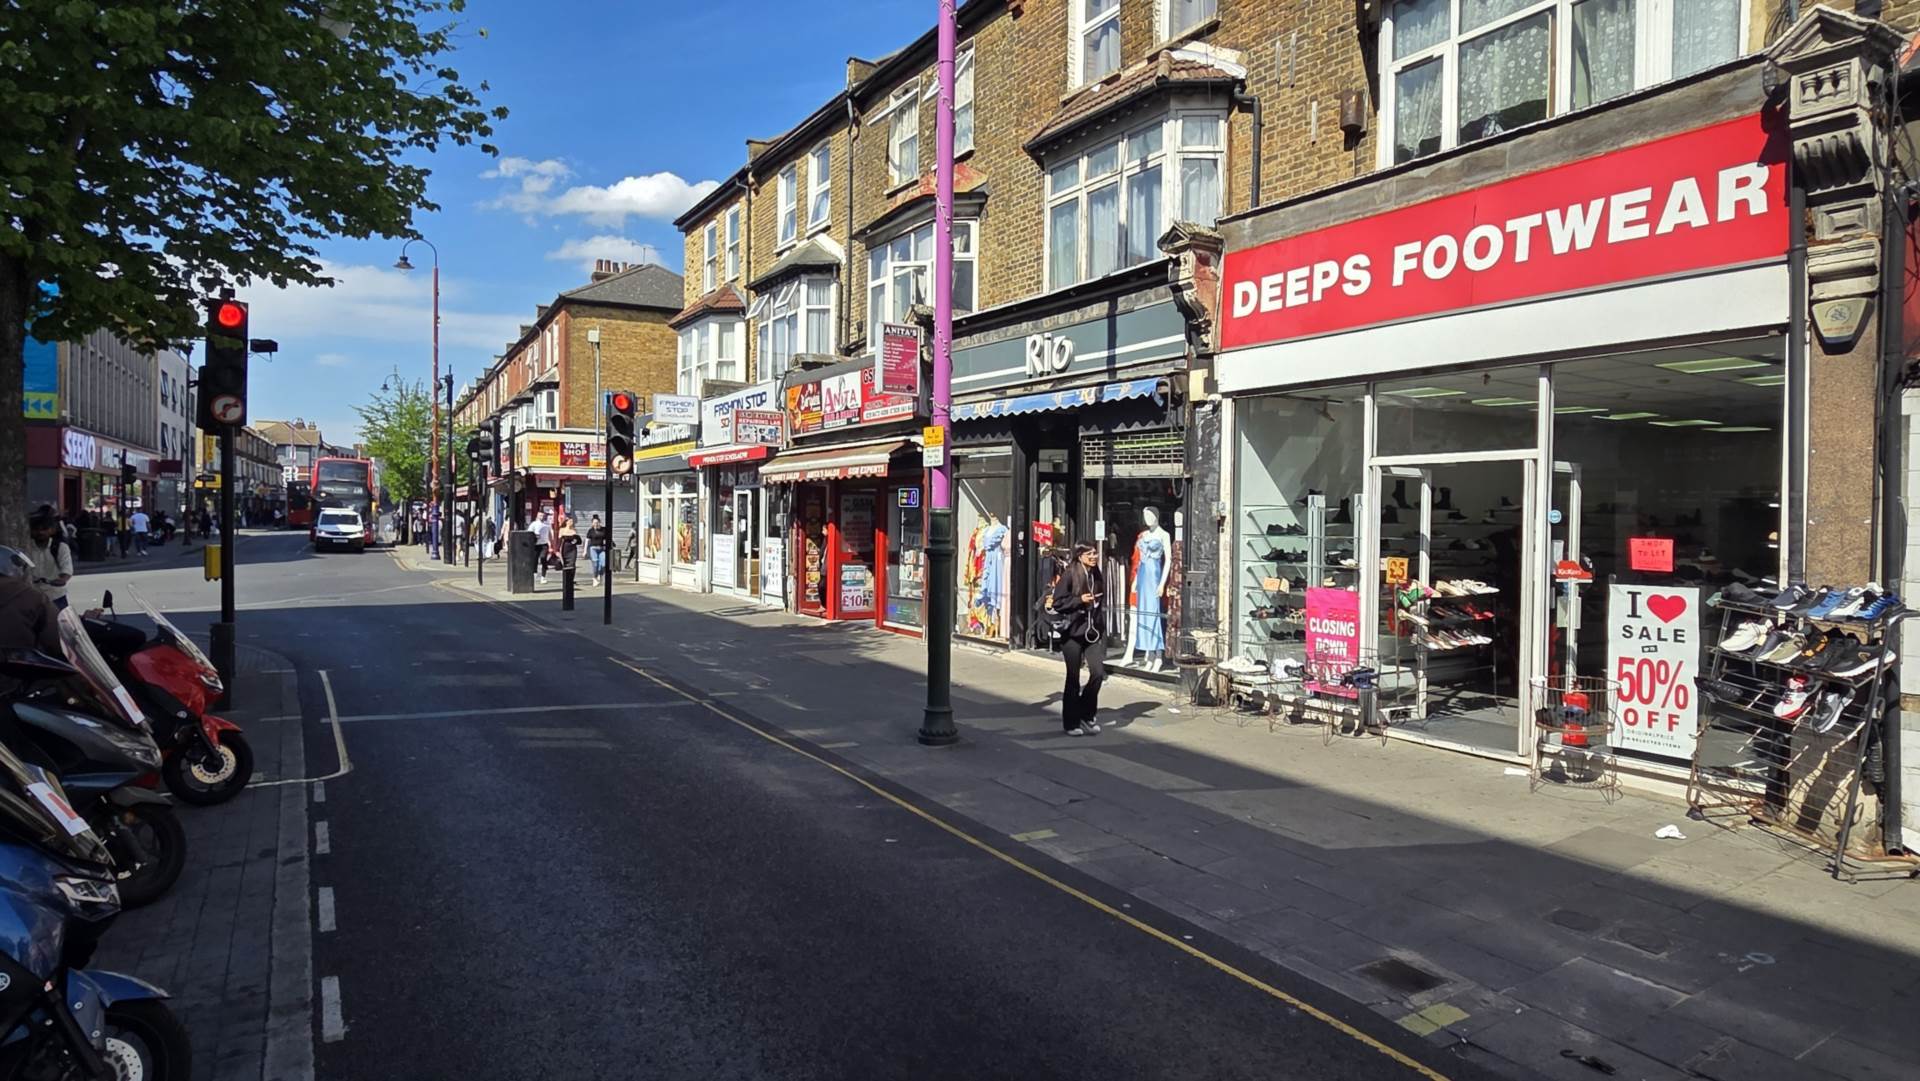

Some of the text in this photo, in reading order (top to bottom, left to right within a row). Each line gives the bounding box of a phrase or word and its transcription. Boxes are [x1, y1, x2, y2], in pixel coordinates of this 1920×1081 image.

[1232, 161, 1770, 318] DEEPS FOOTWEAR
[885, 325, 917, 337] ANITA'S
[864, 368, 876, 384] GS
[659, 399, 695, 408] FASHION
[666, 406, 689, 414] STOP
[746, 391, 767, 410] STOP
[563, 442, 586, 450] VAPE
[563, 448, 588, 456] SHOP
[1626, 590, 1642, 619] I
[1309, 617, 1356, 637] CLOSING
[1621, 624, 1686, 644] SALE
[1315, 637, 1348, 657] DOWN
[1616, 655, 1689, 711] 50%
[1623, 707, 1680, 733] OFF
